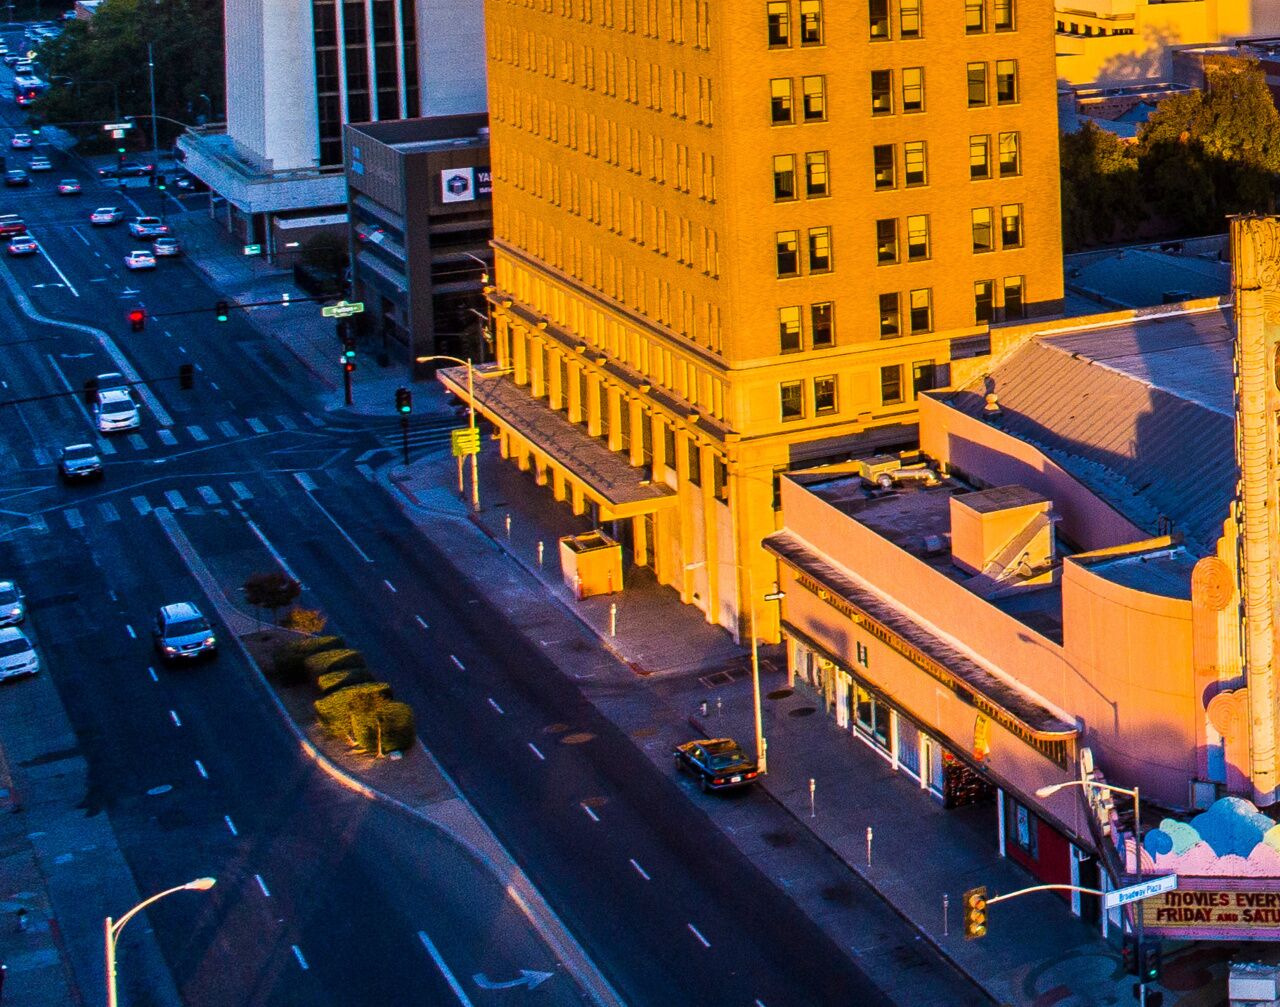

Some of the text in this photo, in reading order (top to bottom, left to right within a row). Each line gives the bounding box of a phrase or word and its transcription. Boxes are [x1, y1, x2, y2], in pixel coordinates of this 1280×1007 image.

[1165, 892, 1229, 907] MOVIES
[1157, 907, 1213, 922] FRIDAY
[1216, 912, 1239, 922] AND
